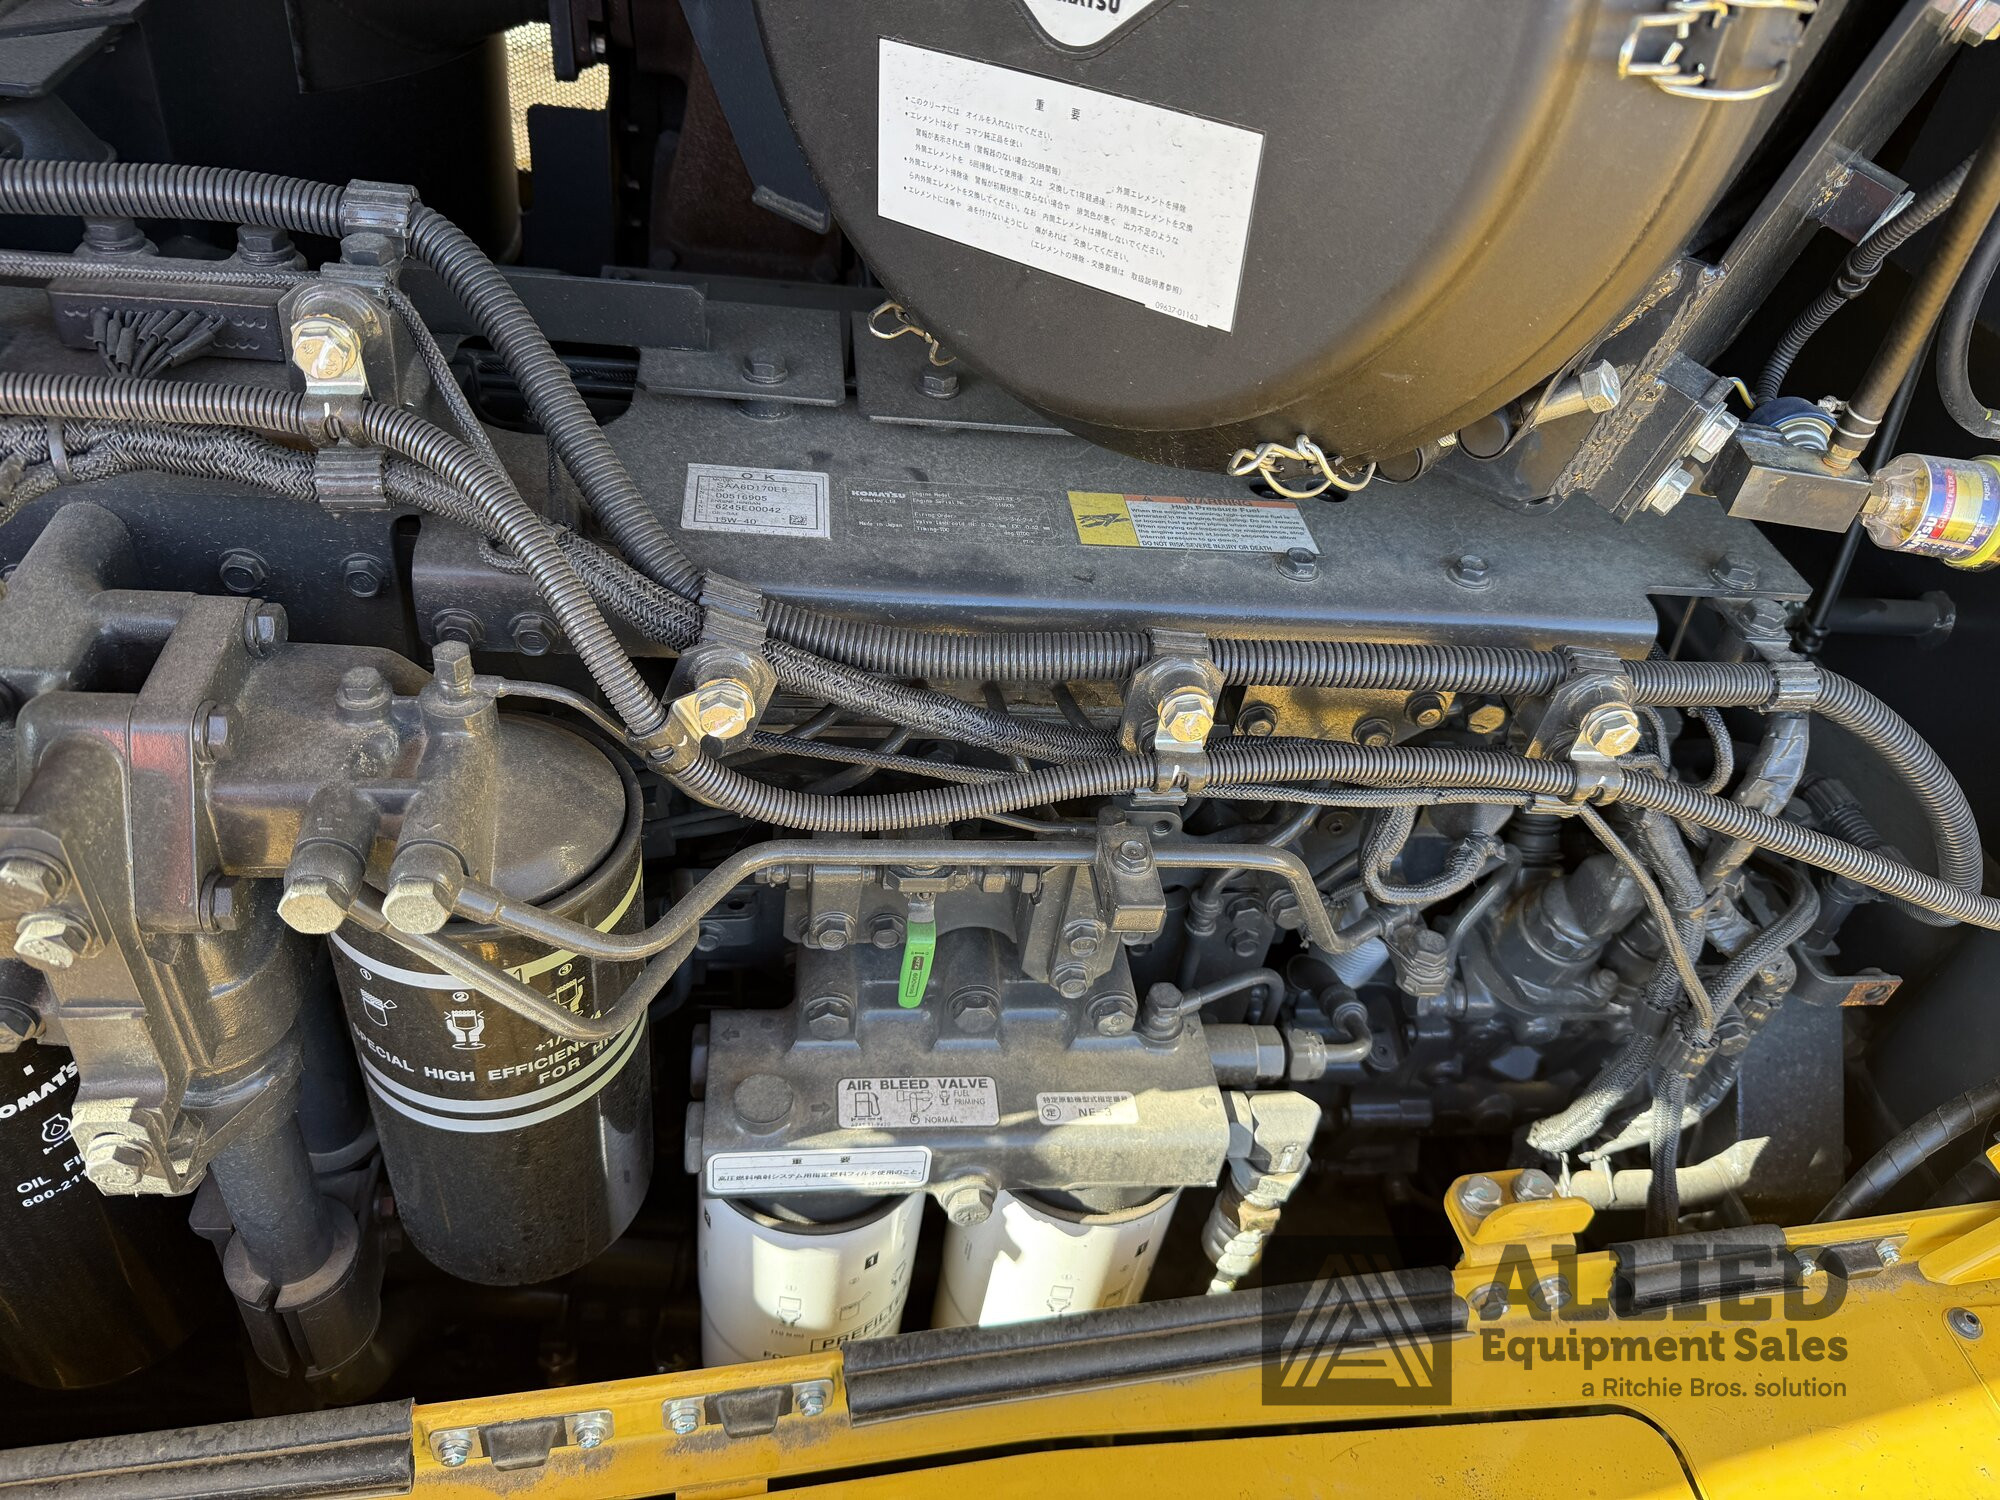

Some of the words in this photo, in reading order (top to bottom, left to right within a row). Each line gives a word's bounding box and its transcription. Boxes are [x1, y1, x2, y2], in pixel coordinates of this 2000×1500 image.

[851, 489, 906, 498] KOMATSU
[1184, 497, 1253, 506] WARNING
[353, 1022, 415, 1073] SPECIAL
[423, 1066, 476, 1082] HIGH
[538, 1056, 581, 1085] FOR
[846, 1079, 872, 1091] AIR
[879, 1079, 930, 1091] BLEED
[937, 1078, 989, 1090] VALVE
[953, 1090, 970, 1098] FUEL
[953, 1098, 986, 1106] PRIMING
[924, 1115, 959, 1124] NORMAL
[17, 1176, 52, 1194] OIL
